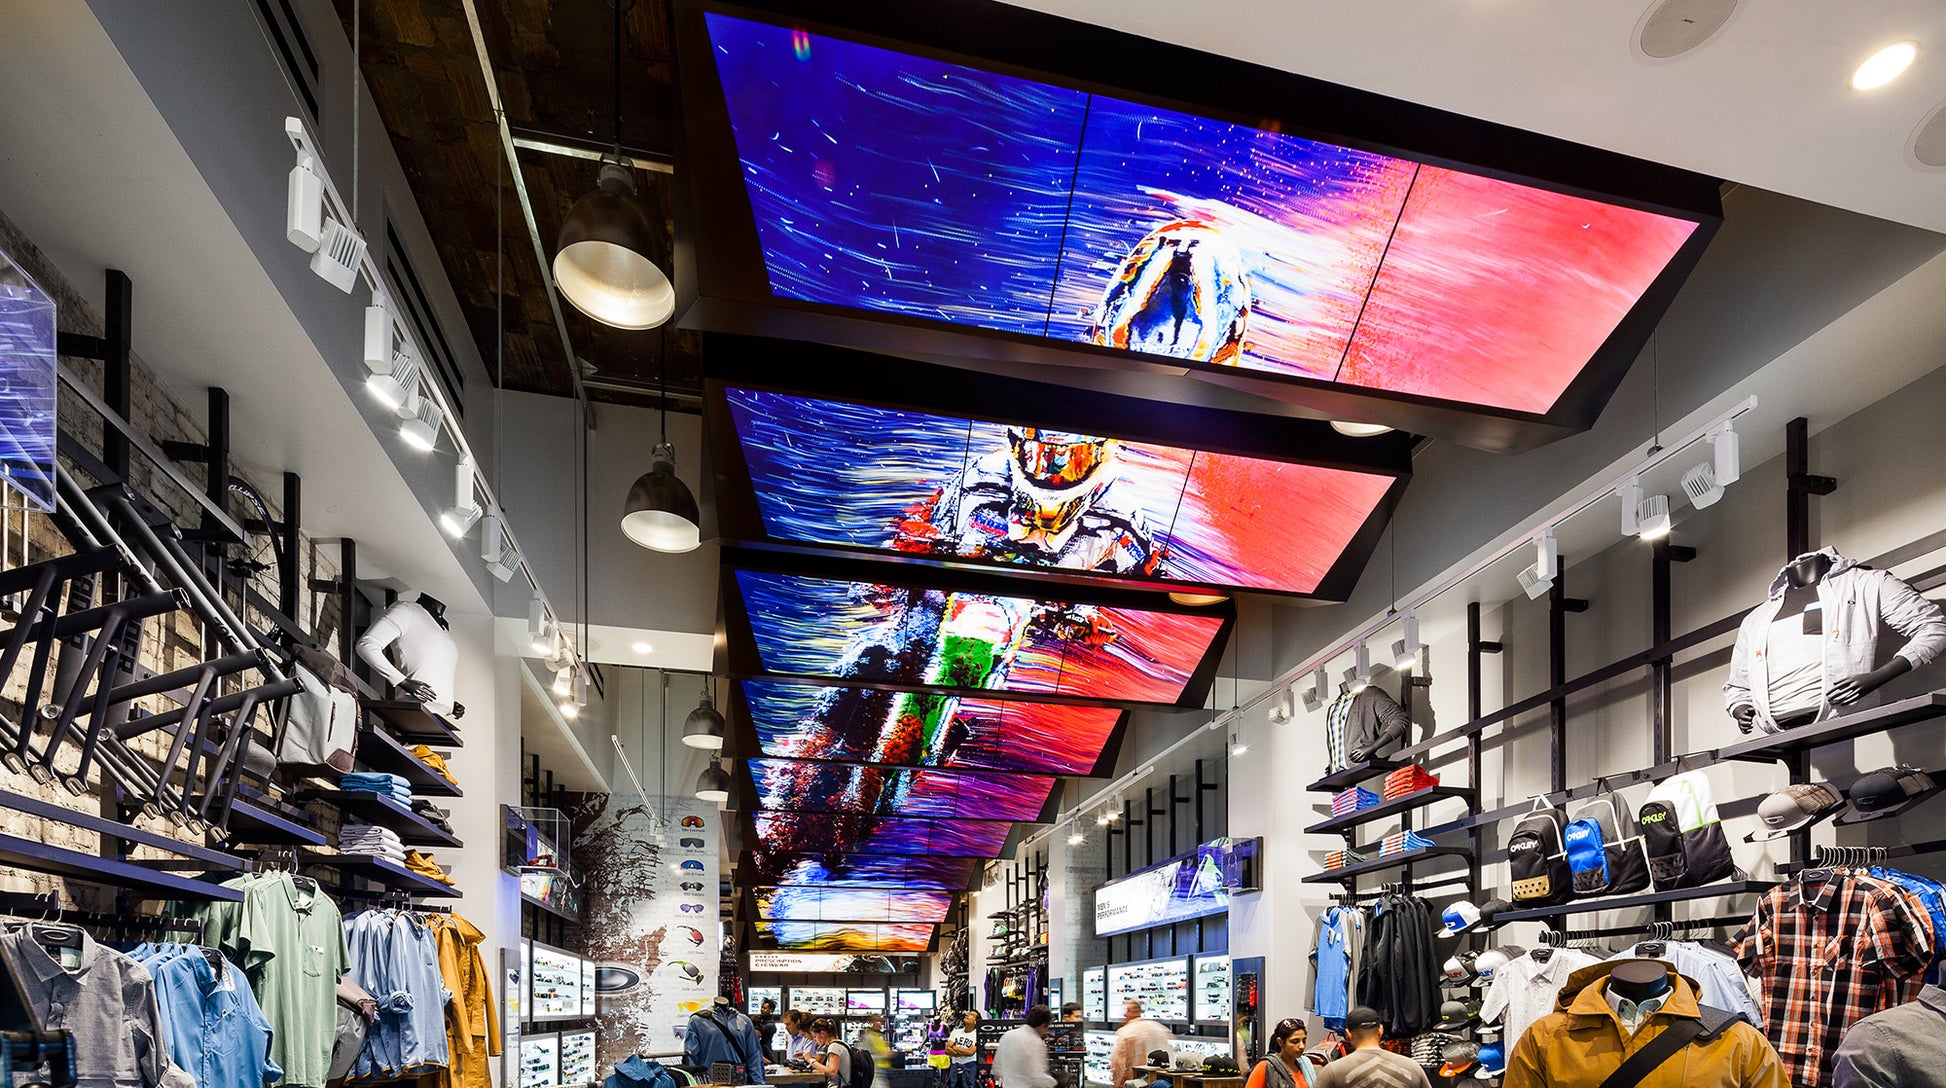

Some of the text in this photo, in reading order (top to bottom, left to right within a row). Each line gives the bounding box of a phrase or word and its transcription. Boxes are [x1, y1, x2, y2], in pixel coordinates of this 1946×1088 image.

[1641, 811, 1667, 825] OAKLEY
[1566, 829, 1590, 842] OAKLEY
[1510, 840, 1539, 853] OAKLEY
[1097, 905, 1129, 920] PERFORMANCE
